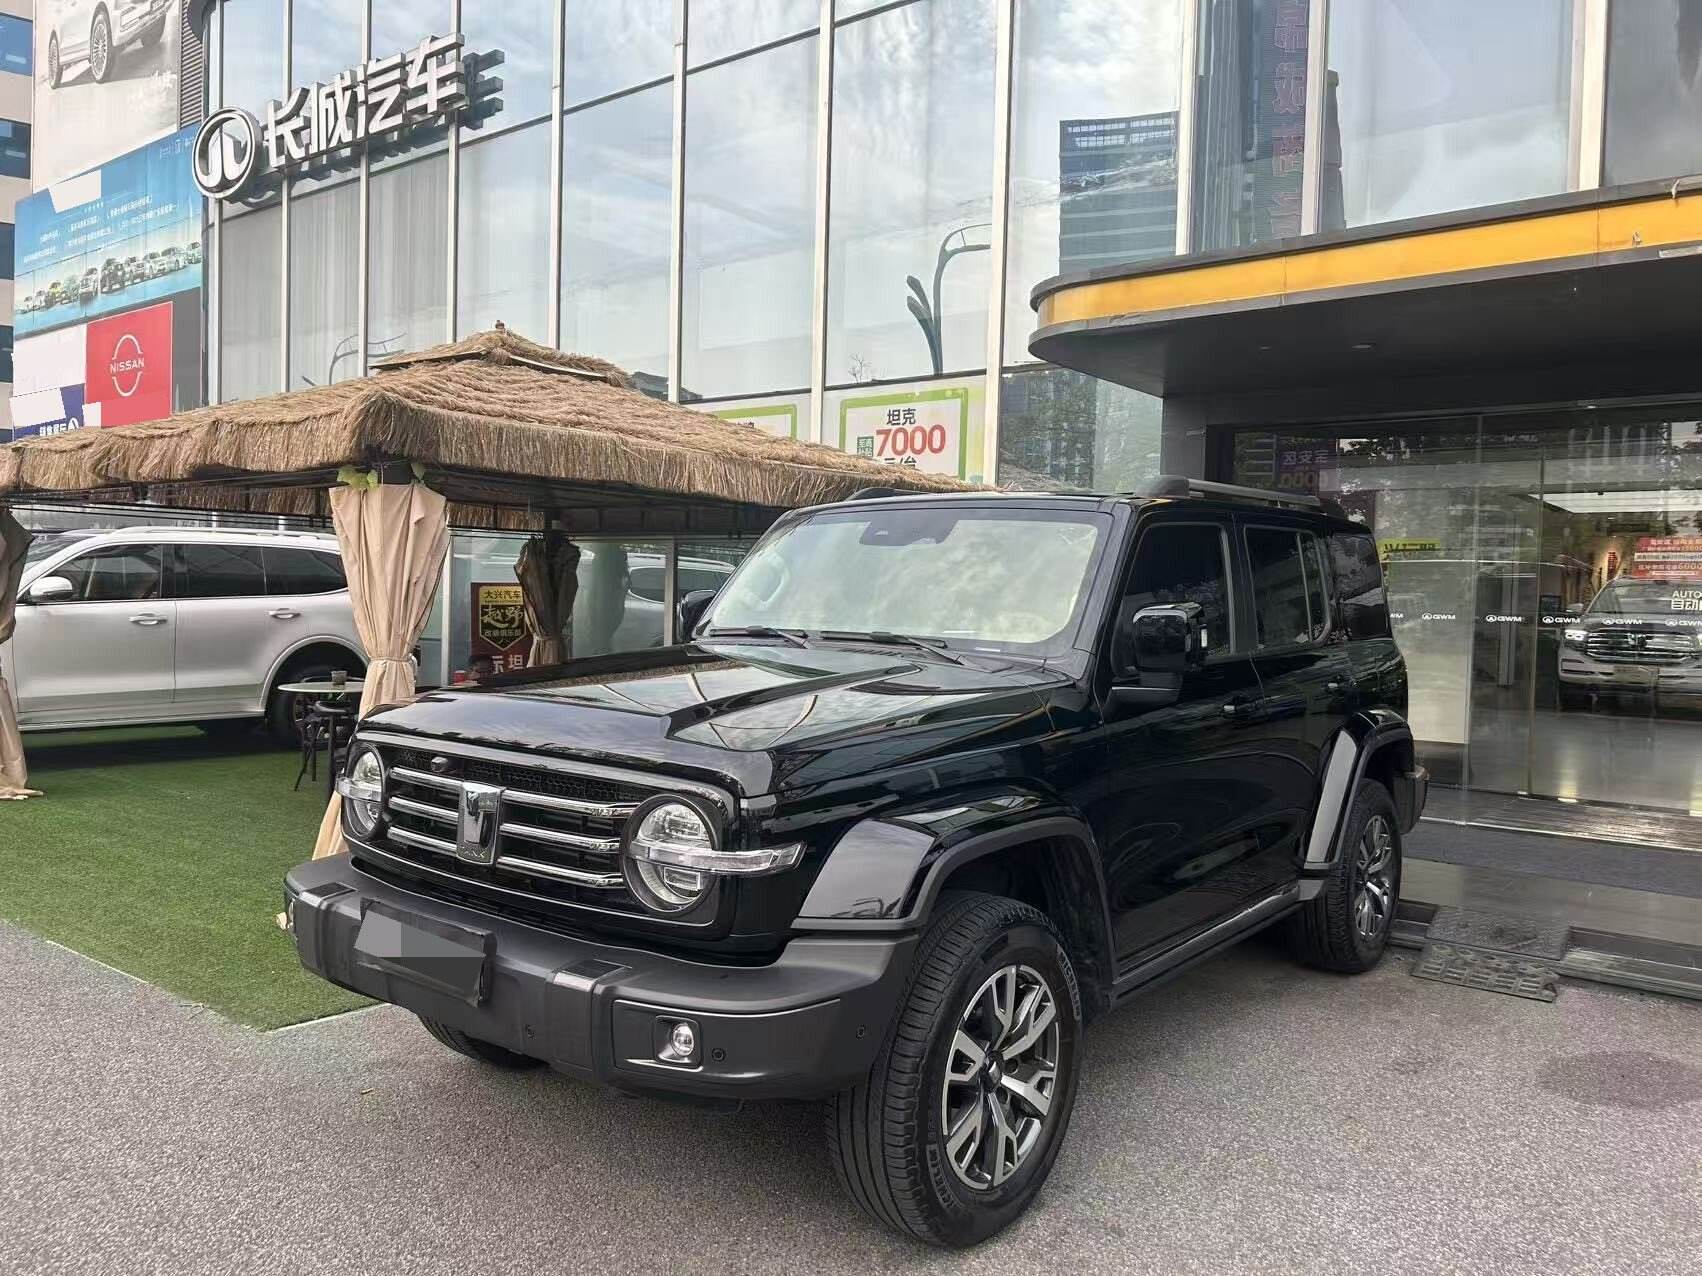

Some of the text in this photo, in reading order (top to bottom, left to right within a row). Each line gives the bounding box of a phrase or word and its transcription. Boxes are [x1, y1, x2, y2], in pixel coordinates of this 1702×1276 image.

[264, 33, 466, 167] 长城汽车
[110, 357, 145, 373] NISSAN
[886, 408, 916, 426] 坦克
[875, 424, 946, 457] 7000
[483, 589, 521, 599] 大兴汽车
[1671, 599, 1702, 610] 自动
[481, 604, 523, 628] 越野
